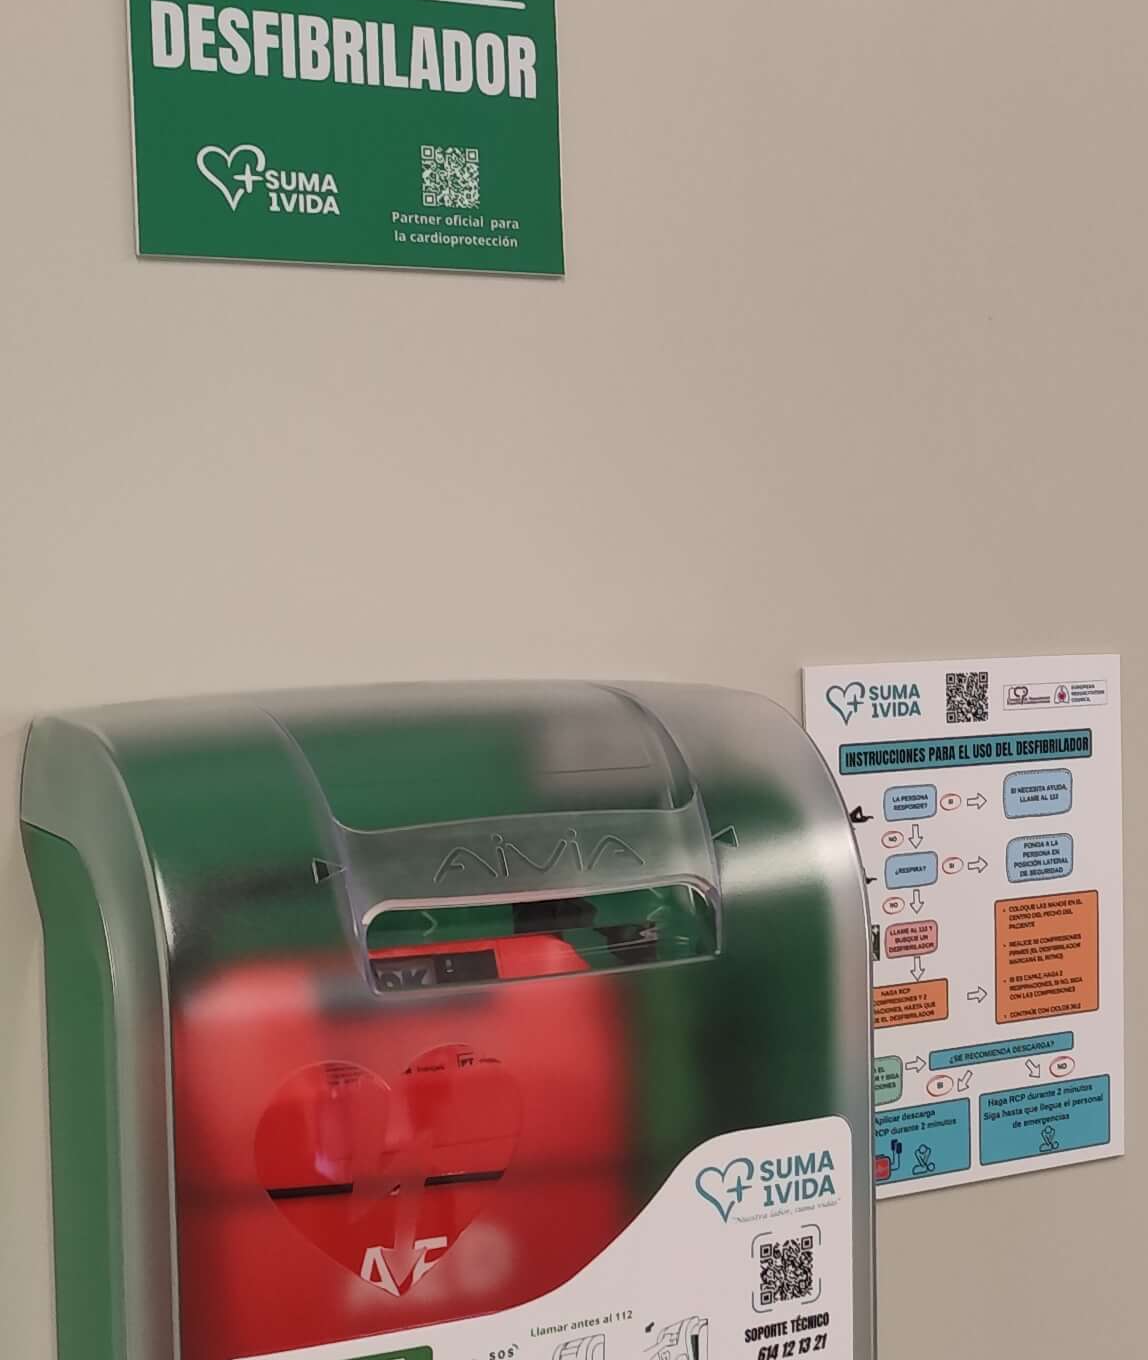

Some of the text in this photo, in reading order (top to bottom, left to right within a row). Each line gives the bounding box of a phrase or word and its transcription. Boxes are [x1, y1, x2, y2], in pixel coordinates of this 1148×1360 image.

[151, 0, 537, 98] DESFIBRILADOR
[265, 170, 338, 193] SUMA
[268, 192, 340, 215] 1VIDA
[392, 211, 520, 231] Partner oficial para
[394, 230, 518, 248] la cardioprotección
[868, 684, 920, 700] SUMA
[871, 701, 921, 718] 1VIDA
[845, 736, 1088, 768] INSTRUCCIONES PARA EL USO DEL DESFIBRILADOR
[983, 1112, 1000, 1121] Siga
[1002, 1107, 1023, 1117] hasta
[1024, 1105, 1038, 1115] que
[1072, 1094, 1104, 1107] personal
[988, 1098, 1008, 1107] Haga
[1009, 1093, 1026, 1103] RCP
[1027, 1089, 1055, 1100] durante
[1056, 1088, 1062, 1096] 2
[901, 1110, 935, 1120] descarga
[1012, 1120, 1022, 1129] de
[760, 1150, 835, 1182] SUMA
[763, 1174, 835, 1207] 1VIDA
[530, 1310, 633, 1337] Llamar antes al 112
[744, 1312, 830, 1343] SOPORTE TÉCNICO
[782, 1340, 796, 1358] 12
[798, 1337, 812, 1355] 13
[812, 1333, 827, 1351] 21
